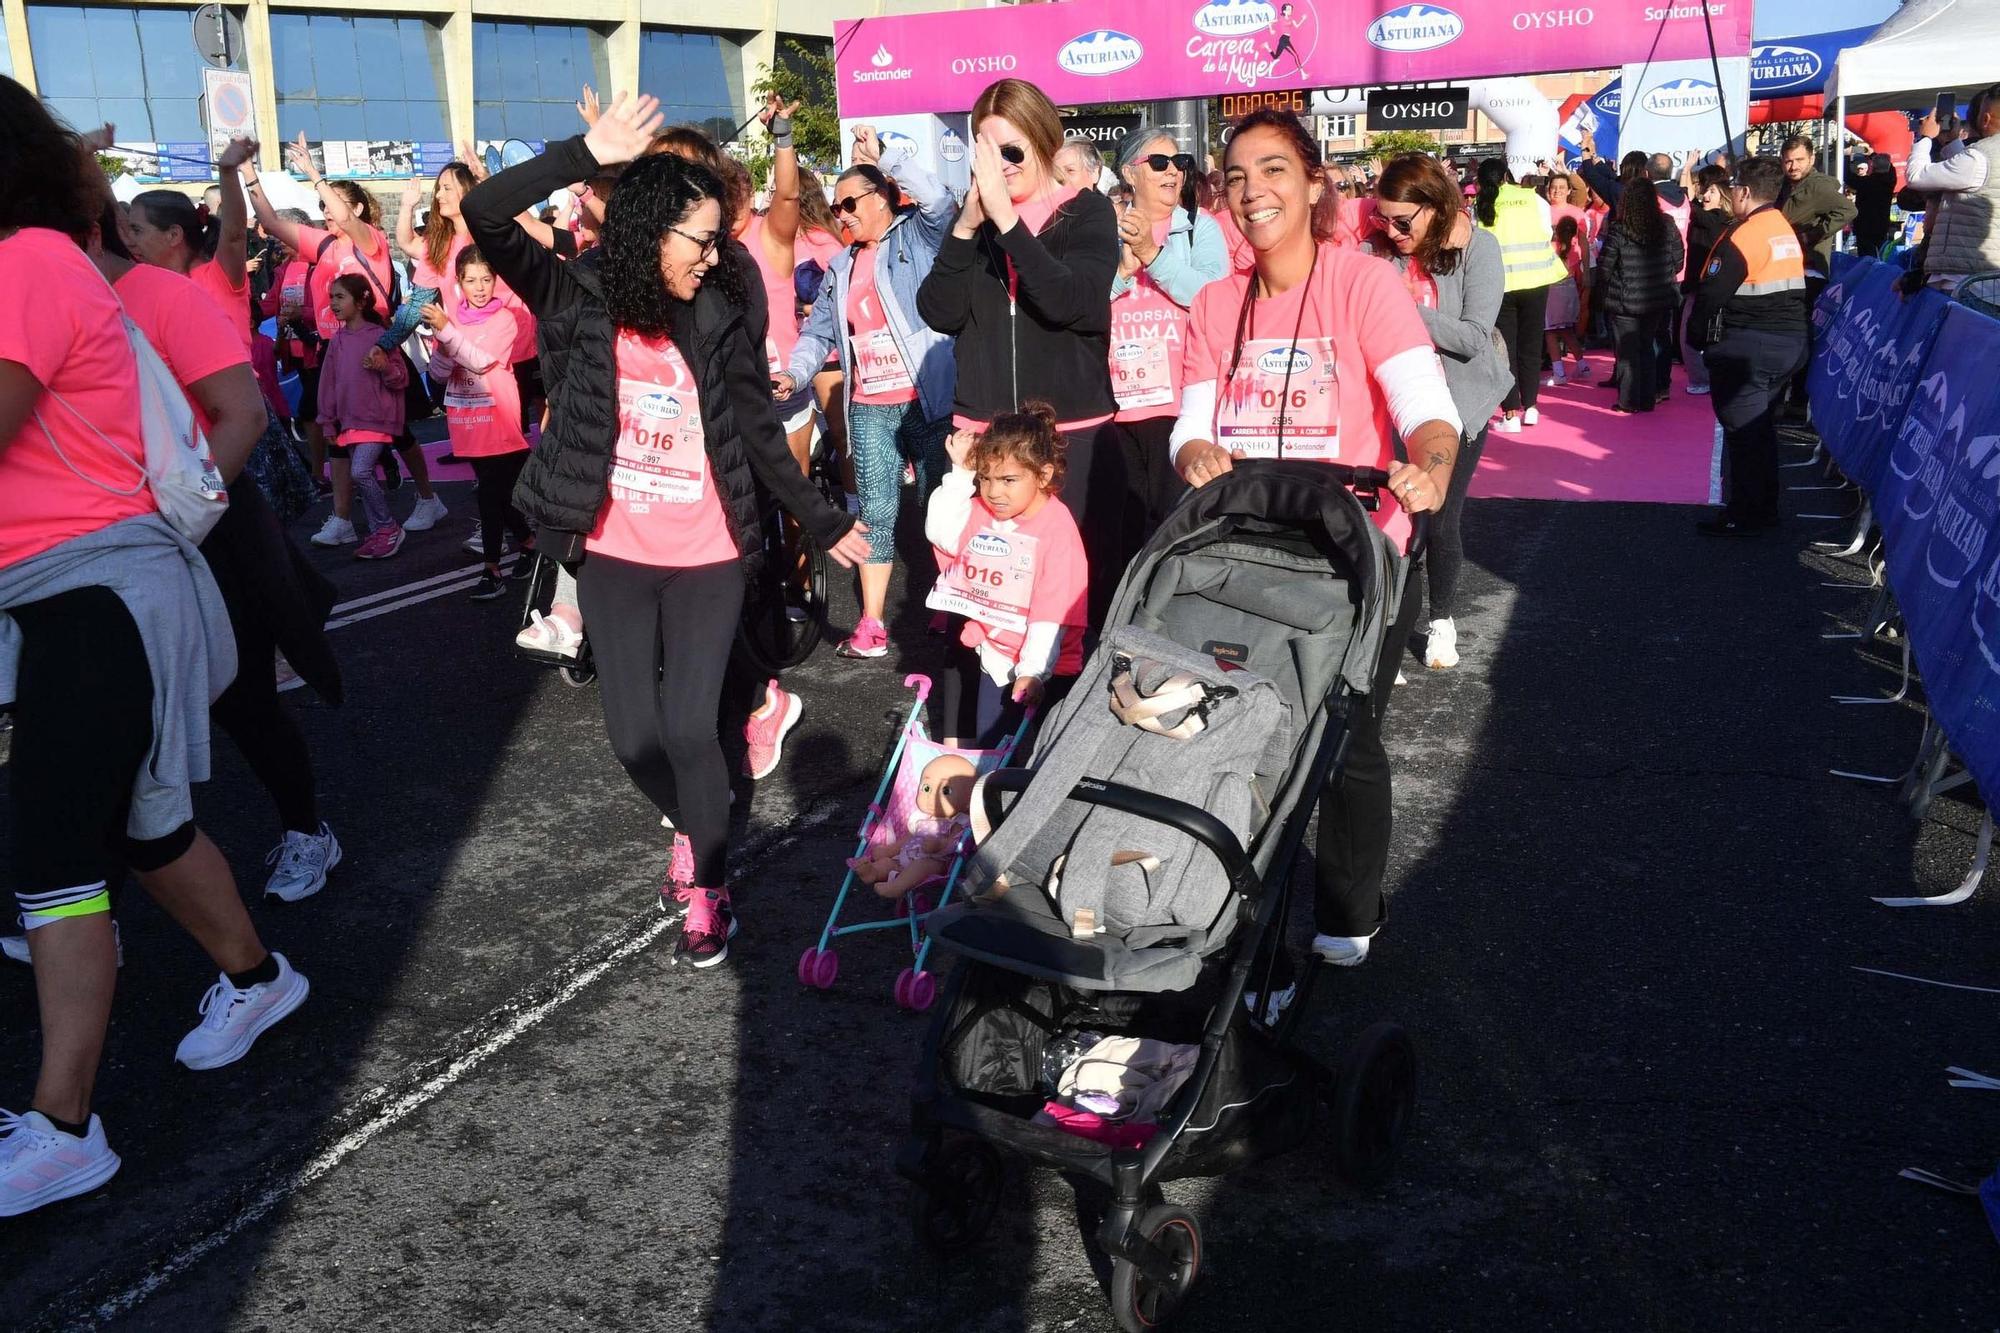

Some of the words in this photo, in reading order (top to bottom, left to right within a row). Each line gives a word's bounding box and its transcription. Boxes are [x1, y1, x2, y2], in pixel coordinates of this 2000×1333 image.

[1200, 12, 1270, 27] ASTURIANA
[1513, 8, 1593, 30] OYSHO
[1374, 24, 1455, 41] ASTURIANA
[1186, 36, 1254, 57] Carrera
[952, 55, 1016, 74] OYSHO
[1065, 49, 1136, 66] ASTURIANA
[1775, 55, 1810, 64] LECHERA
[853, 68, 912, 83] Santander
[1203, 59, 1216, 72] de
[1218, 57, 1227, 72] la
[1225, 53, 1280, 87] Mujer
[1750, 63, 1812, 80] URIANA
[1381, 101, 1454, 119] OYSHO
[1648, 95, 1719, 110] ASTURIANA
[1121, 308, 1182, 324] DORSAL
[874, 353, 899, 367] 016
[635, 429, 674, 451] 016
[1230, 441, 1270, 451] OYSHO
[1294, 441, 1327, 451] Santander
[641, 454, 661, 465] 2997
[971, 539, 1009, 555] ASTURIANA
[964, 565, 1004, 587] 016
[970, 587, 990, 598] 2996
